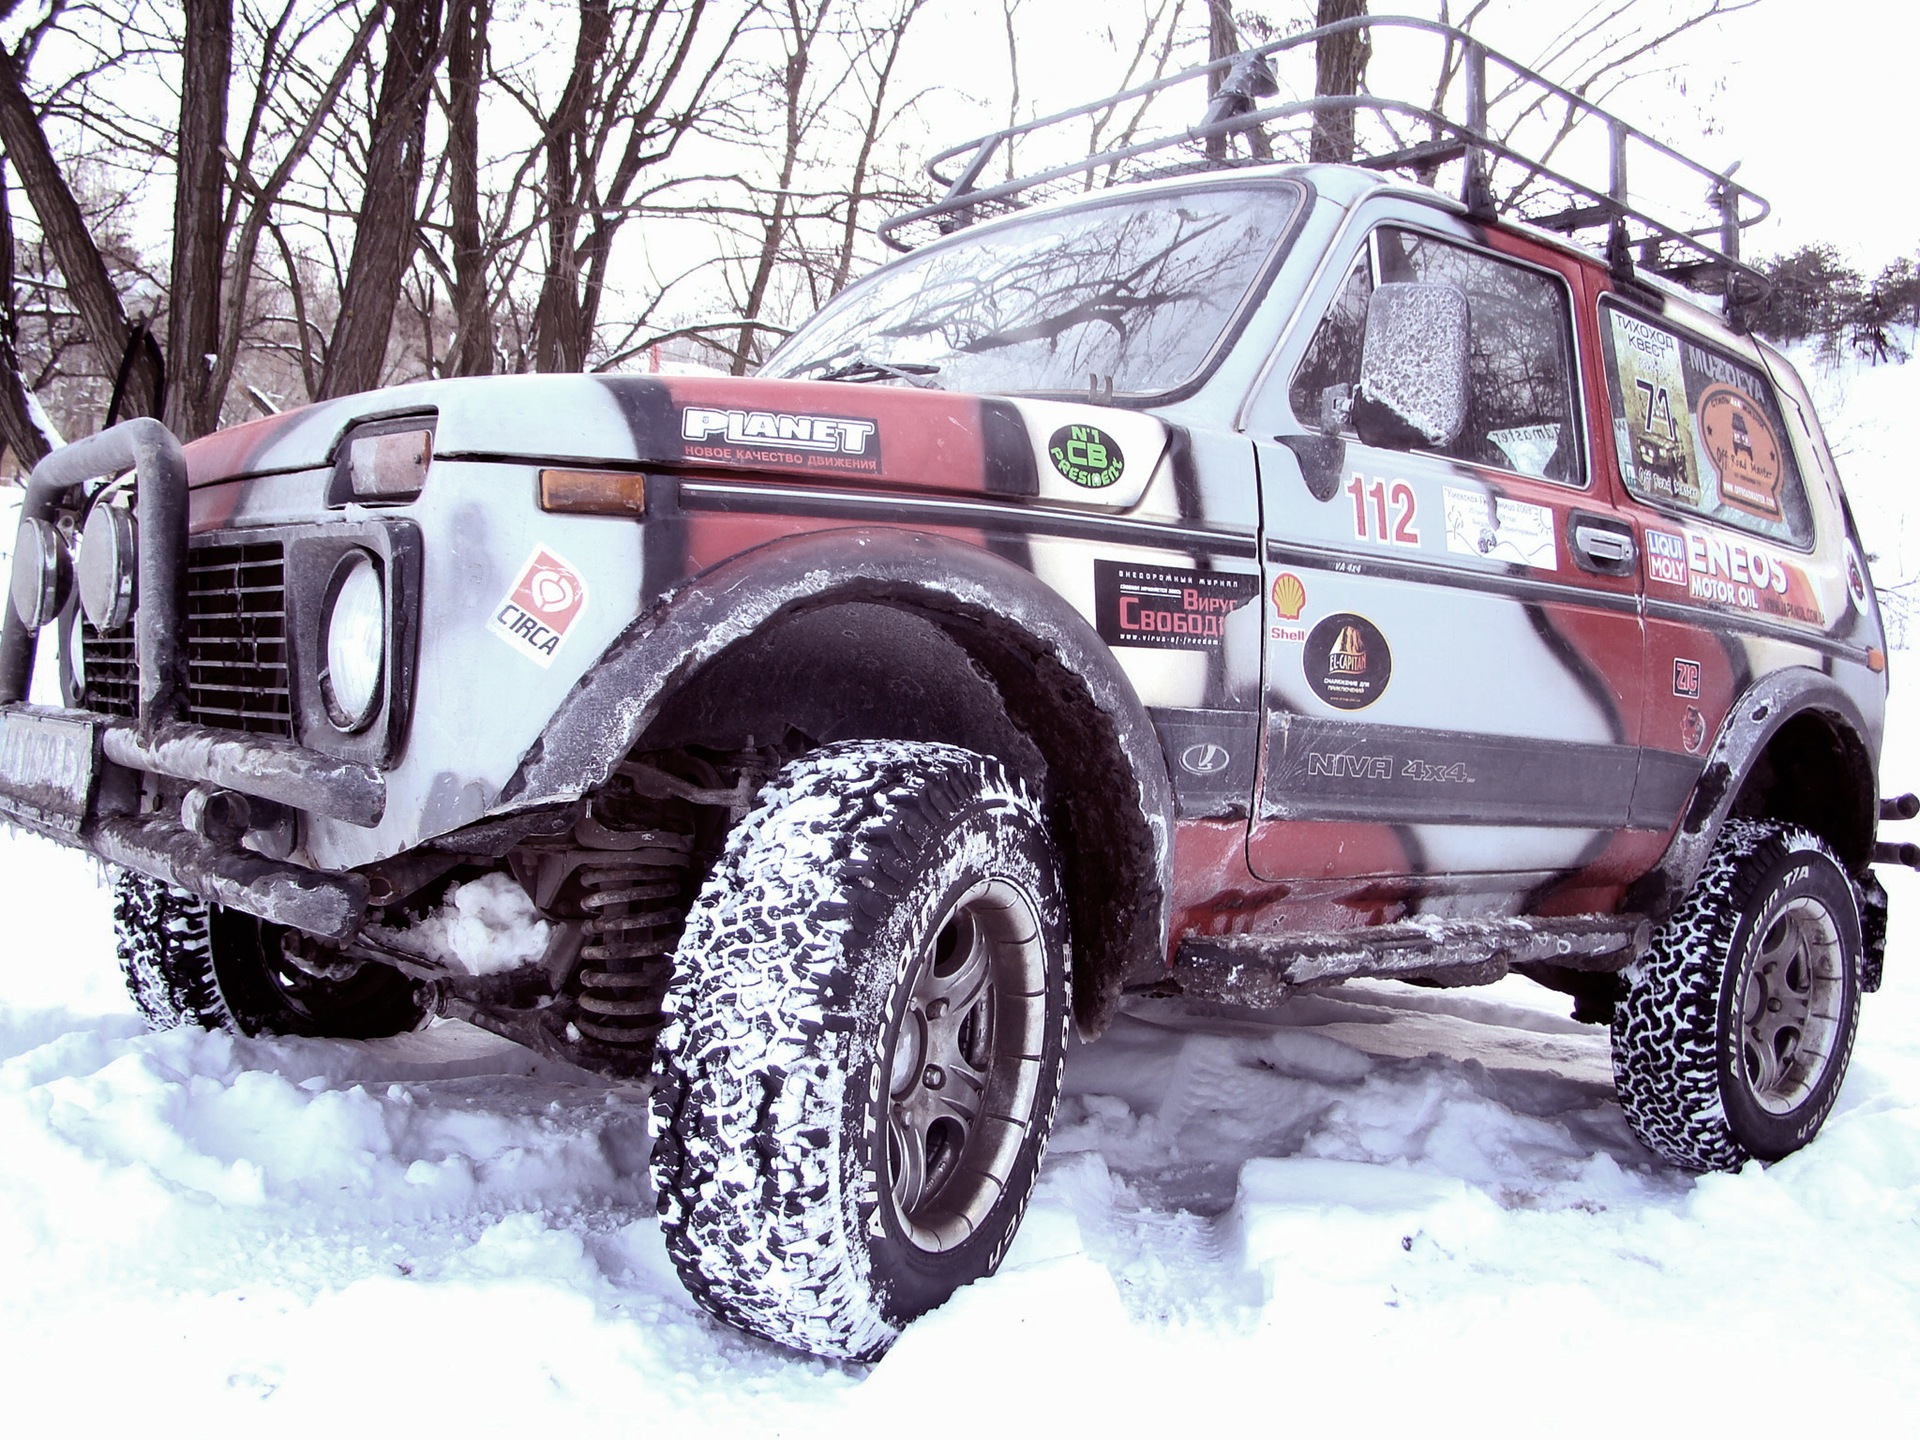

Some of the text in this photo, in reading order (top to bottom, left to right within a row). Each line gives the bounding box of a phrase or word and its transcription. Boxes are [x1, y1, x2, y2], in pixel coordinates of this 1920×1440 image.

[1615, 314, 1674, 352] ТИХОХОД
[1628, 334, 1665, 359] КВЕСТ
[682, 406, 875, 454] PLANET
[684, 446, 876, 470] НОВОЕ КАЧЕСТВО ДВИЖЕНИЯ
[1067, 440, 1107, 469] CB
[1347, 477, 1419, 544] 112
[1648, 531, 1684, 561] LIQUI
[1650, 555, 1686, 582] MOLY
[1690, 535, 1788, 594] ENEOS
[1691, 576, 1759, 609] MOTOR OIL
[1271, 627, 1305, 641] Shell
[1329, 653, 1367, 671] EL-CAPITAN
[1676, 663, 1698, 691] ZIC
[1308, 753, 1467, 783] NIVA 4x4
[1783, 865, 1810, 889] T/A
